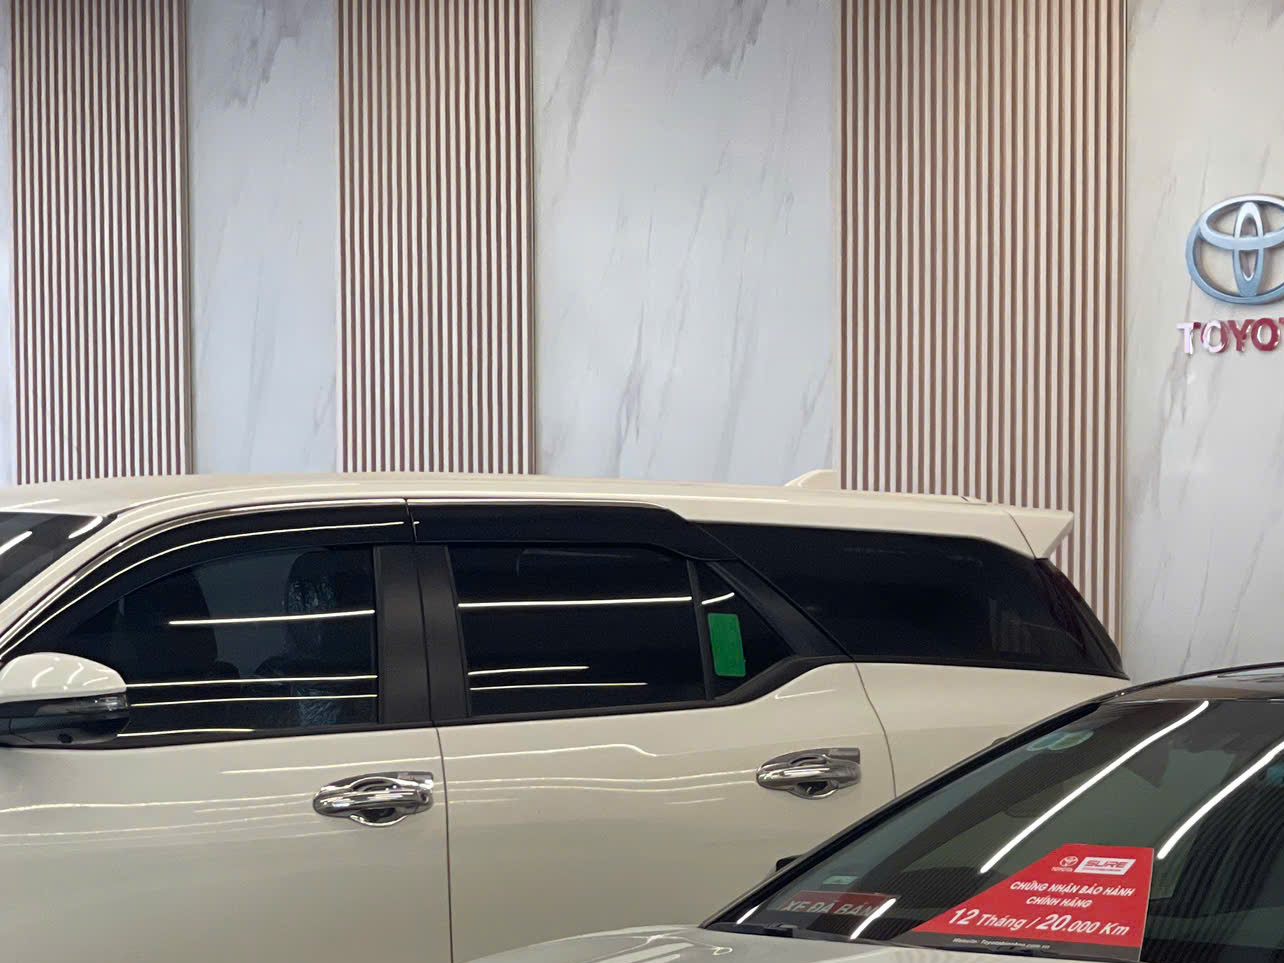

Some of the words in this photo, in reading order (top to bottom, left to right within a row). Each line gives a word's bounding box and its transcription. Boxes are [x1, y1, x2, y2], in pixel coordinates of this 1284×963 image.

[949, 908, 979, 925] 12
[977, 914, 1027, 931] Tháng
[1025, 917, 1040, 928] /
[1036, 914, 1100, 934] 20.000
[1099, 922, 1130, 936] Km
